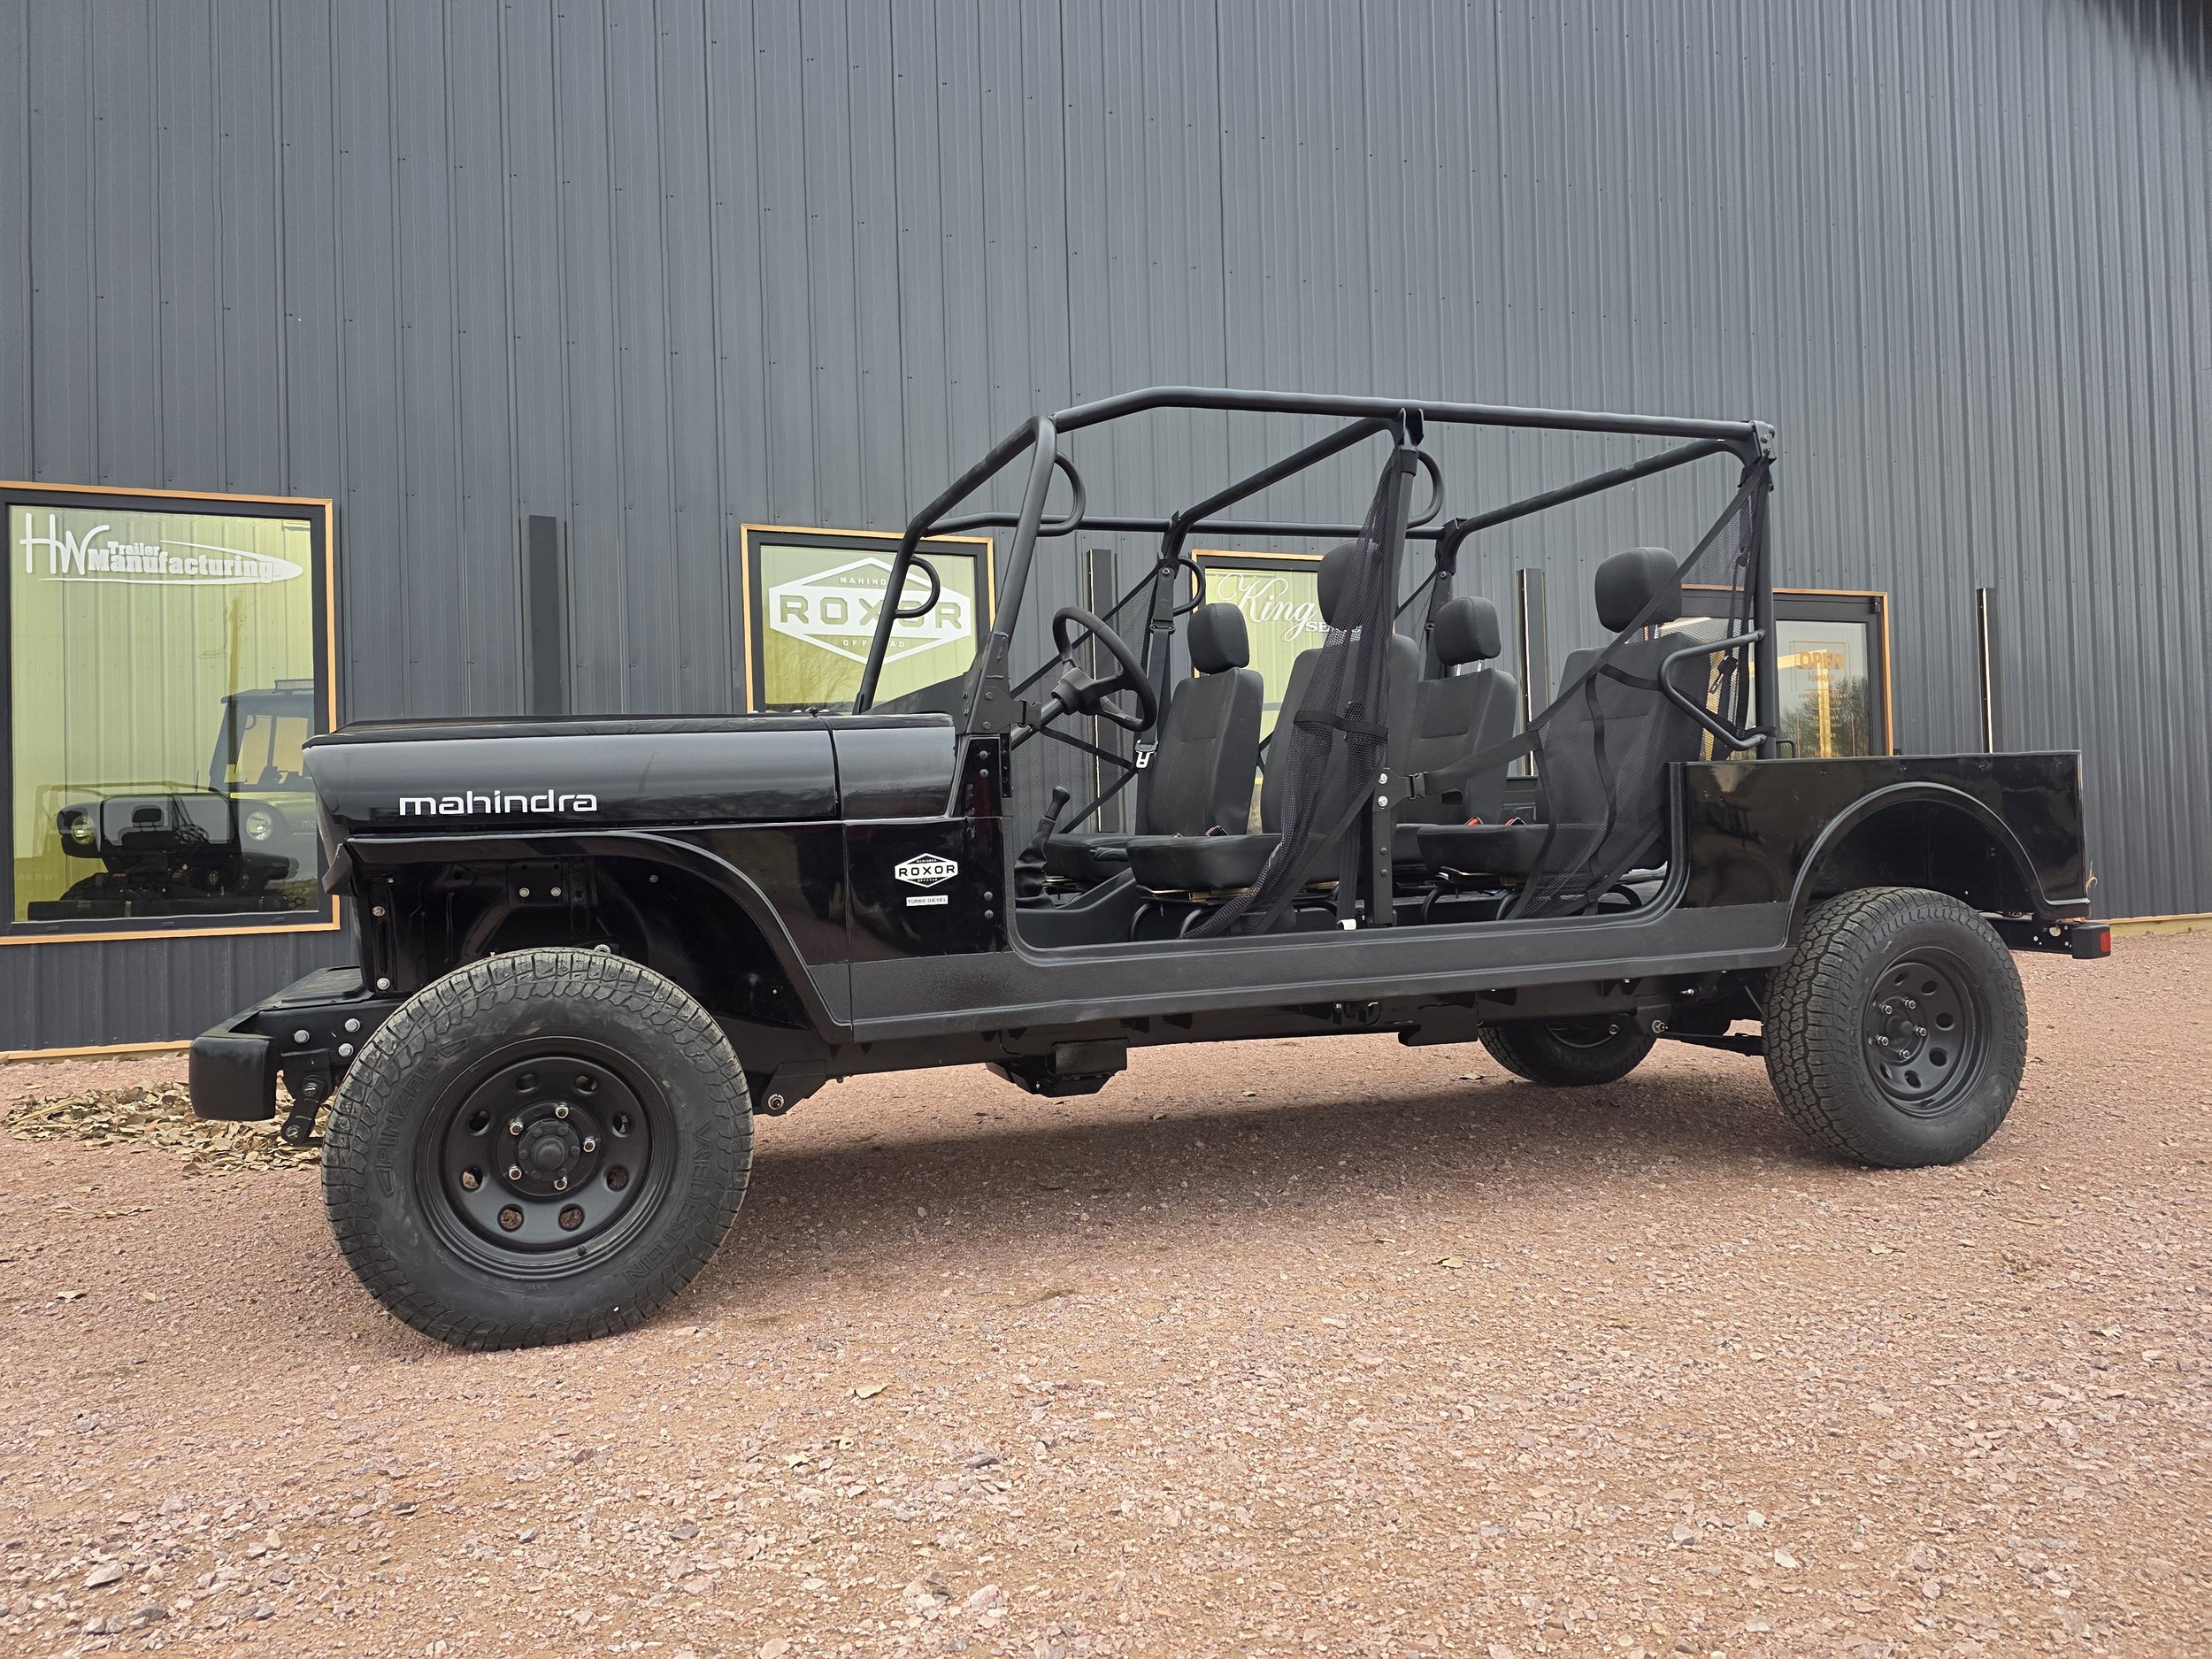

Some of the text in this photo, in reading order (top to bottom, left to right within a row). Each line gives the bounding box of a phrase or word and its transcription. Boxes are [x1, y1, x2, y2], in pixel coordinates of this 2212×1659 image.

[107, 541, 161, 557] Trailer
[88, 549, 273, 583] Manufacturing
[1217, 573, 1318, 641] King
[842, 639, 905, 648] OFFAD
[1799, 650, 1845, 670] OPEN
[399, 788, 597, 816] mahindra
[898, 864, 956, 878] ROXOR
[622, 1118, 711, 1287] VREDESTEIN
